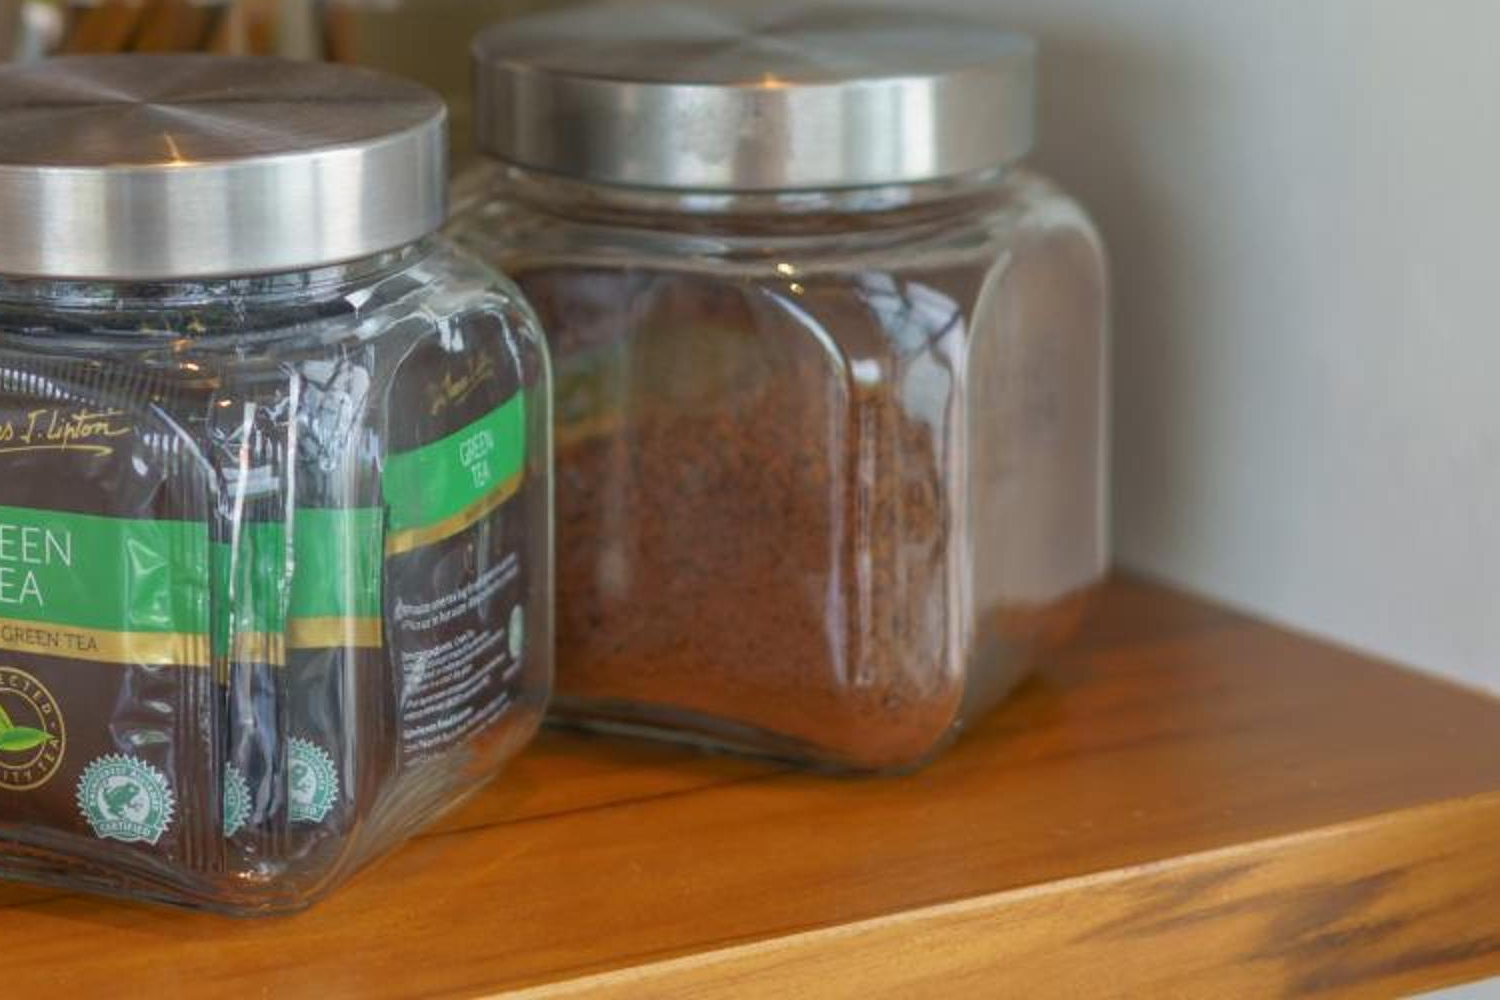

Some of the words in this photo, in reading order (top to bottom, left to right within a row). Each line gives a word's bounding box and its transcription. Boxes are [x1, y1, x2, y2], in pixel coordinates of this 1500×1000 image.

[47, 408, 131, 451] Lipton
[460, 430, 494, 467] GREEN
[471, 459, 491, 488] TEA
[1, 623, 60, 648] GREEN
[63, 632, 99, 652] TEA
